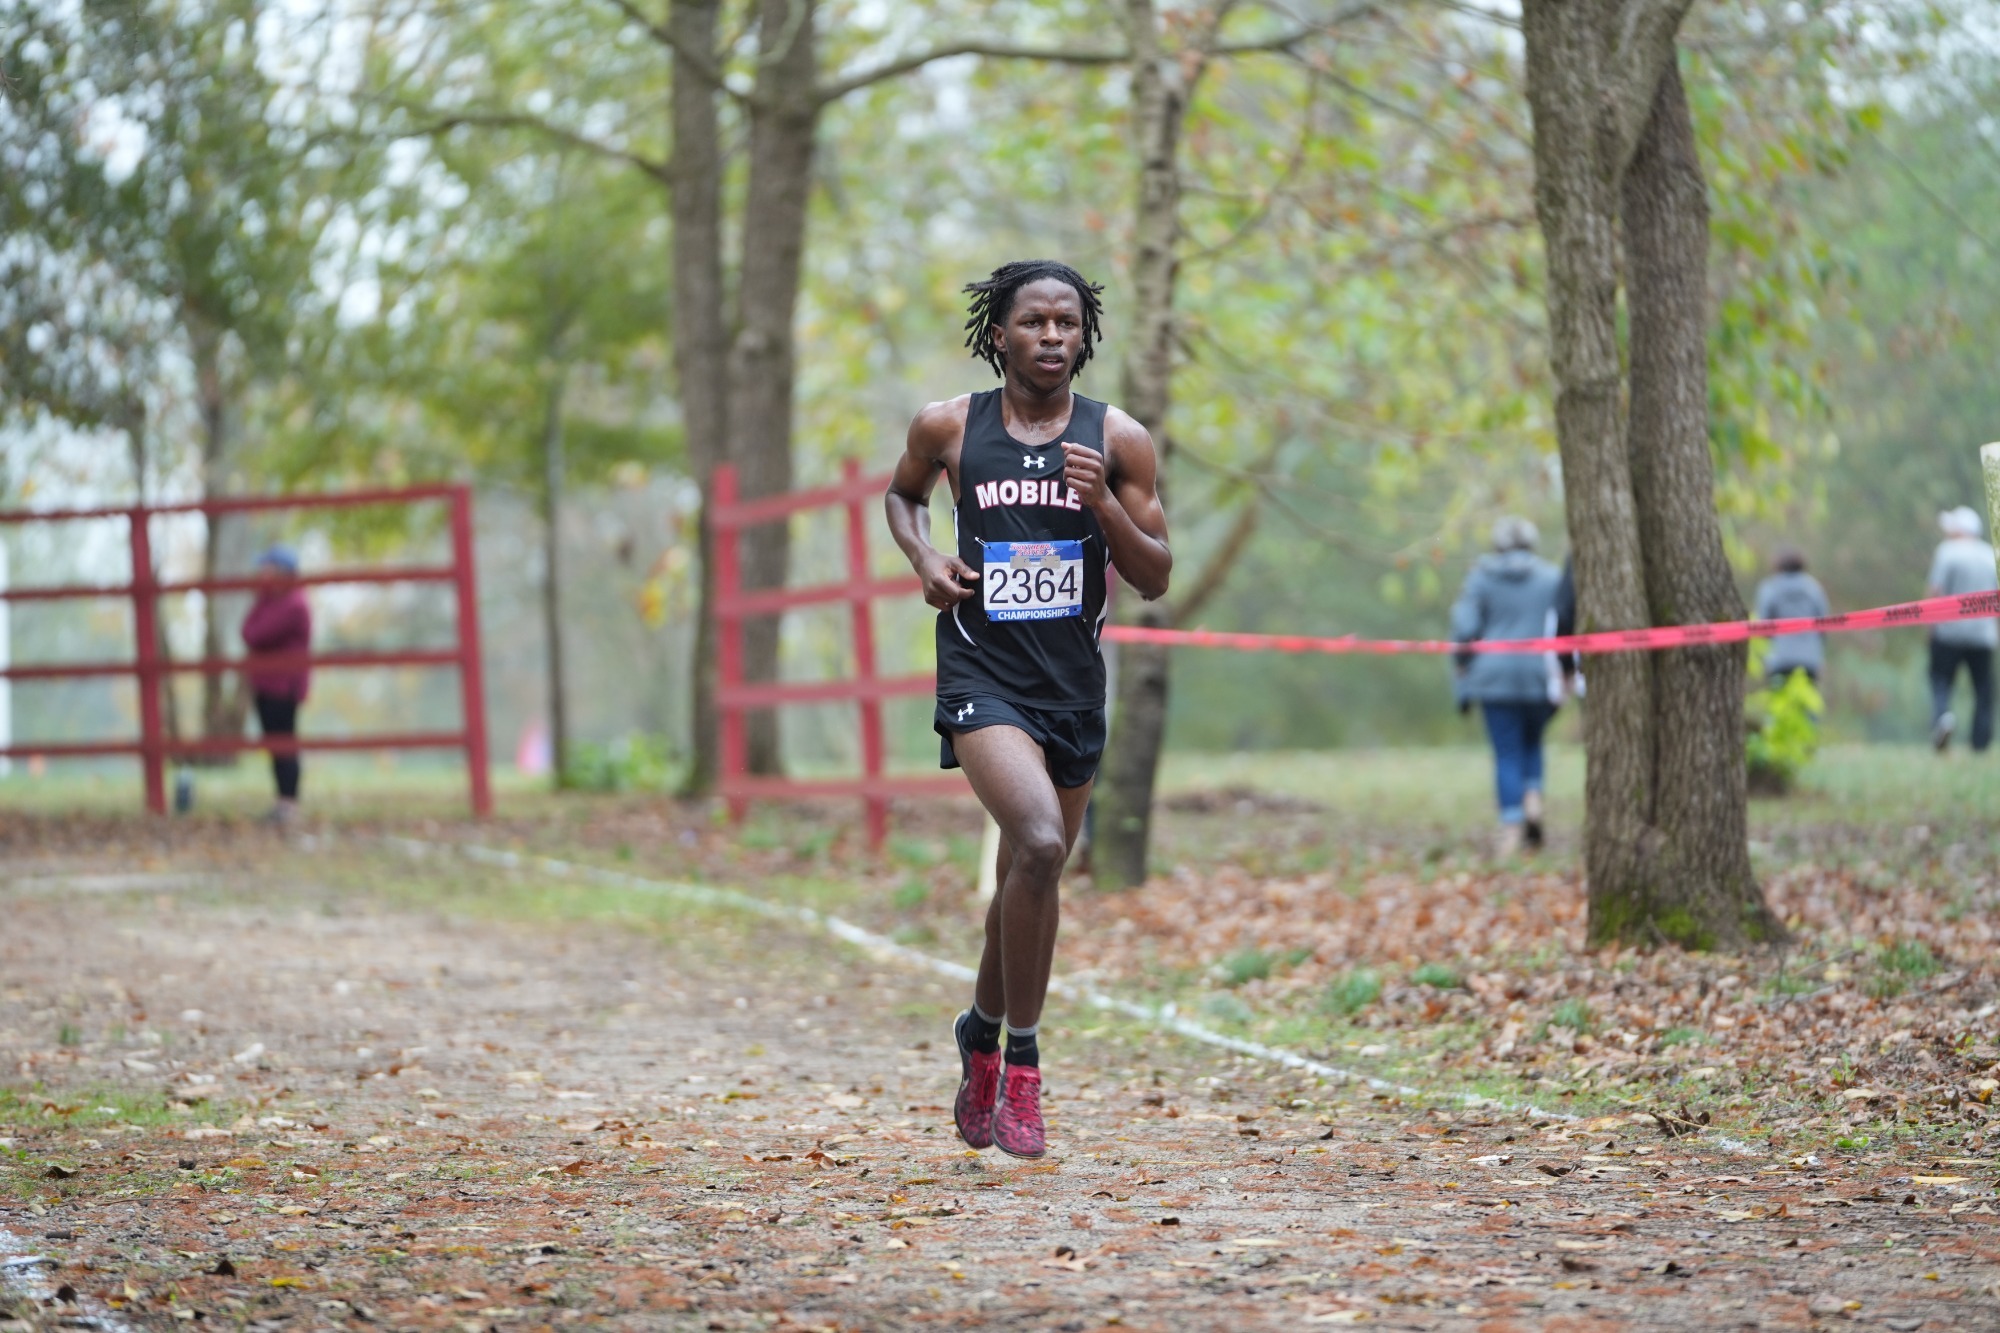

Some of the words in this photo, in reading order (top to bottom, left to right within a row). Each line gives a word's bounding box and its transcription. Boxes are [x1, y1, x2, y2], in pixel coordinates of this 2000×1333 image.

[974, 479, 1082, 512] MOBILE
[988, 565, 1078, 604] 2364
[997, 607, 1070, 620] CHAMPIONSHIPS
